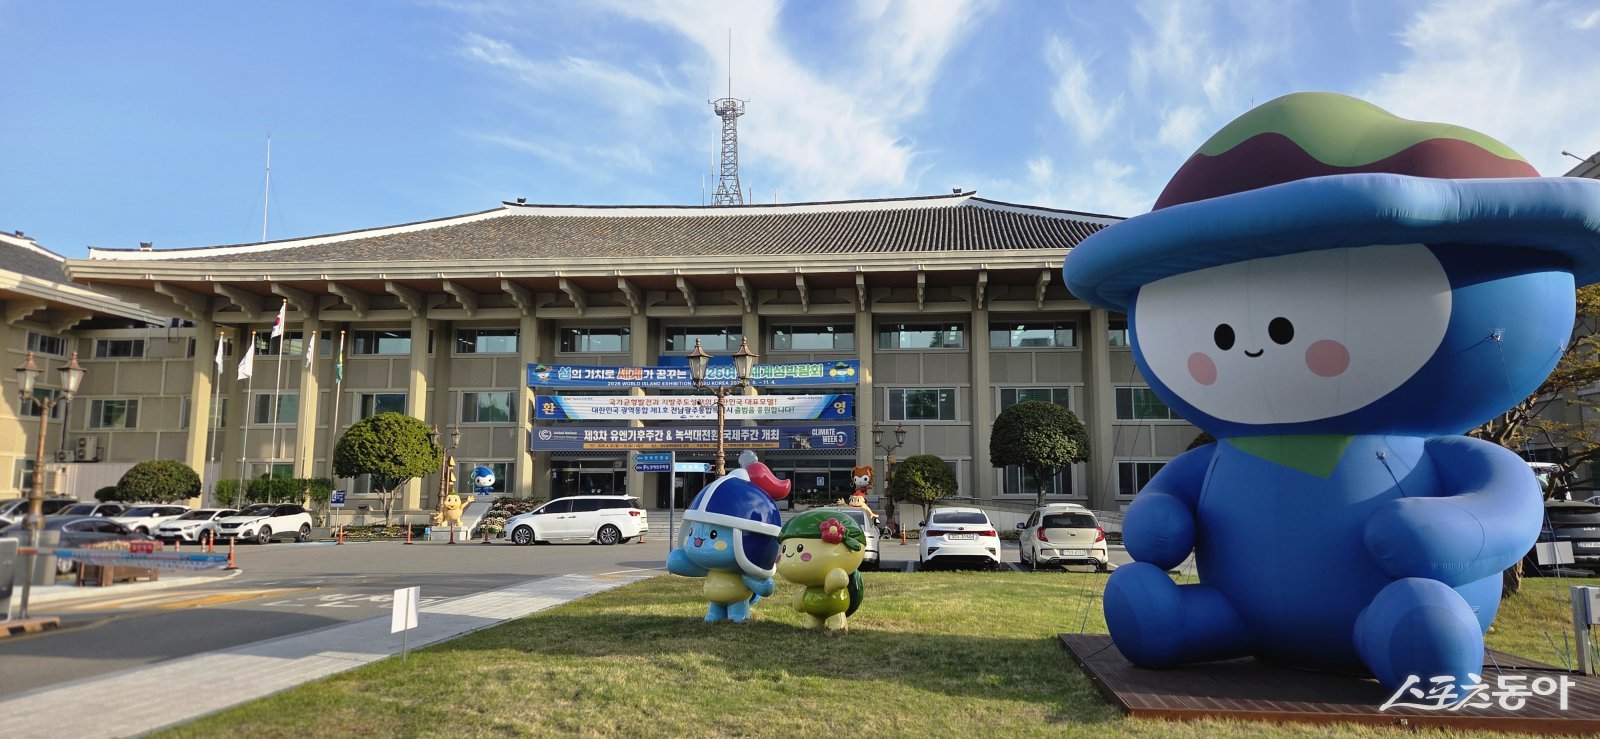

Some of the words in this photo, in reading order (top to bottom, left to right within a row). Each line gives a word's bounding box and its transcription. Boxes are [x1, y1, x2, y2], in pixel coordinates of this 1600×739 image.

[558, 366, 582, 380] 섬의
[584, 369, 615, 380] 가치로
[616, 367, 654, 380] 세계가
[656, 369, 687, 380] 꿈꾸는
[608, 398, 659, 406] 국가균형발전과
[744, 398, 777, 406] 대표모델!
[542, 402, 556, 415] 환
[591, 406, 619, 414] 대한민국
[621, 406, 648, 414] 광역통합
[650, 406, 669, 414] 제1호
[671, 406, 733, 414] 전남광주통합특시
[734, 406, 755, 414] 출범을
[757, 406, 795, 414] 응원합니다!
[833, 401, 846, 415] 영
[583, 429, 608, 441] 제3차
[610, 429, 664, 441] 유엔기후주간
[665, 429, 673, 441] &
[675, 429, 719, 441] 녹색대전환
[723, 429, 758, 441] 국제주간
[761, 428, 780, 440] 개최
[811, 428, 836, 436] CLIMATE
[822, 435, 837, 443] WEEK
[838, 435, 843, 443] 3
